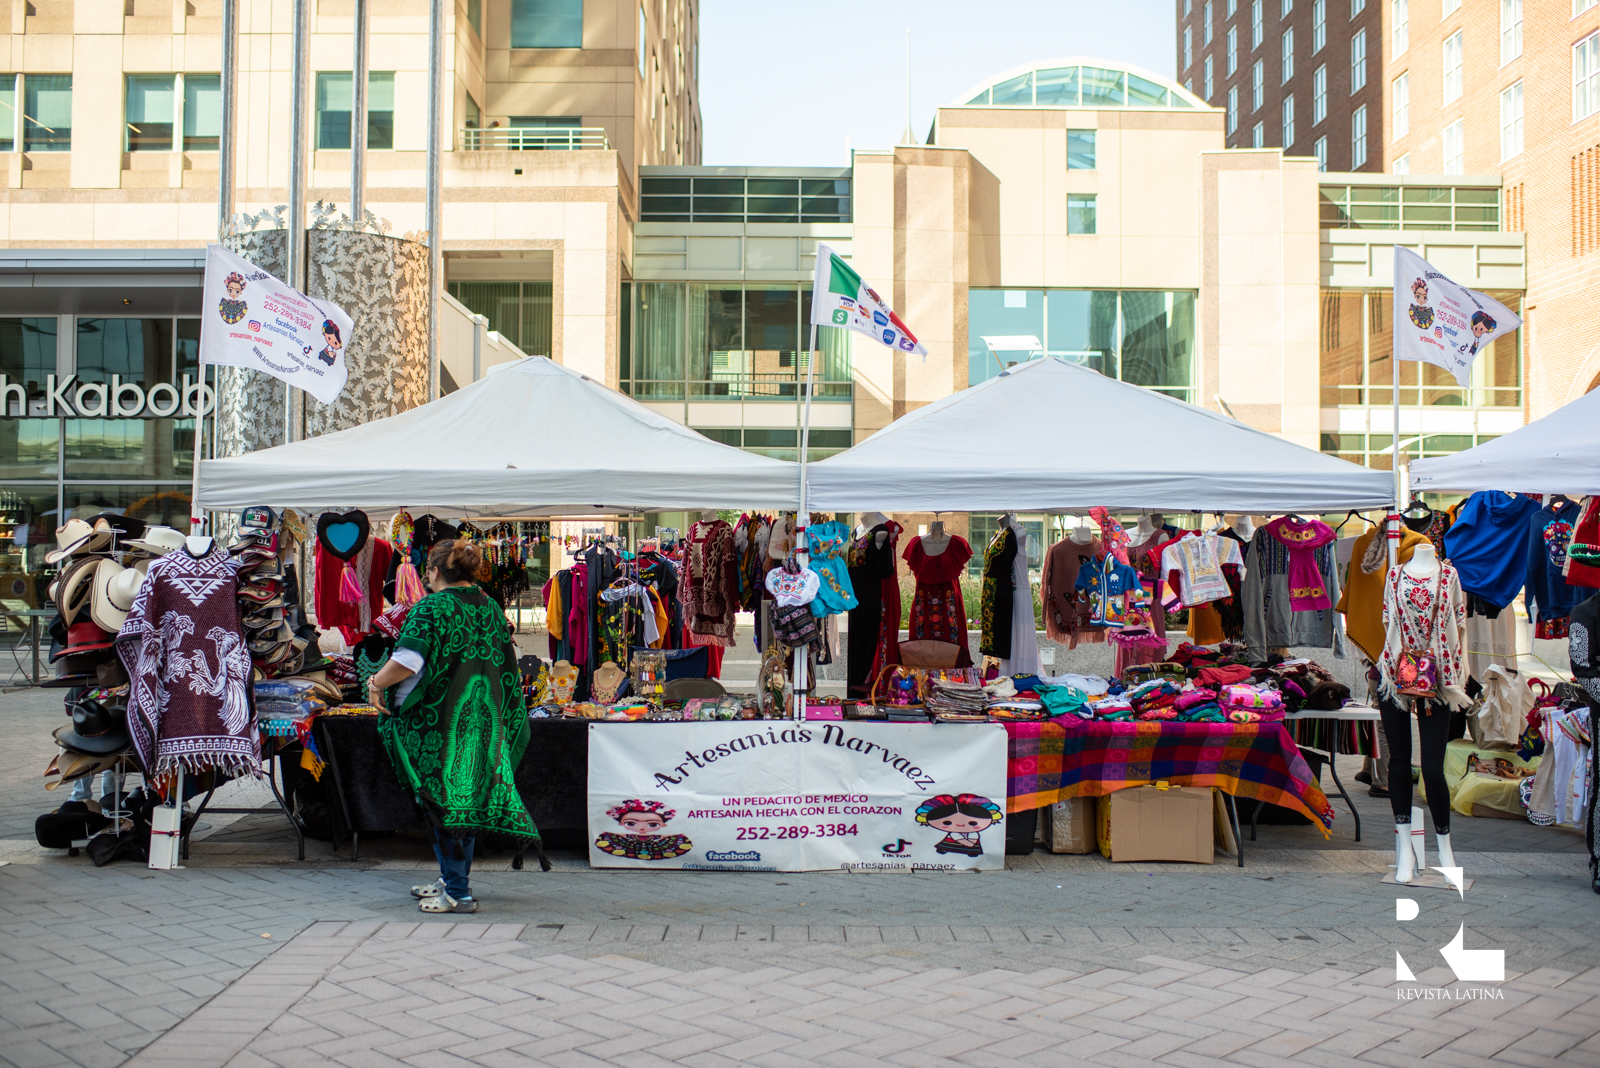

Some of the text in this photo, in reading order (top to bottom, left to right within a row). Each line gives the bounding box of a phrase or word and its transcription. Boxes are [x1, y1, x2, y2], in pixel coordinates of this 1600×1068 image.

[263, 300, 312, 330] 252-289-3384
[276, 317, 298, 334] facebook
[47, 374, 215, 417] Kabob
[653, 724, 936, 792] Artesanias Narvaez
[722, 794, 868, 806] UN PEDACITO DE MEXICO
[687, 806, 902, 818] ARTESANIA HECHA CON EL CORAZON
[736, 823, 858, 840] 252-289-3384
[707, 852, 759, 860] facebook
